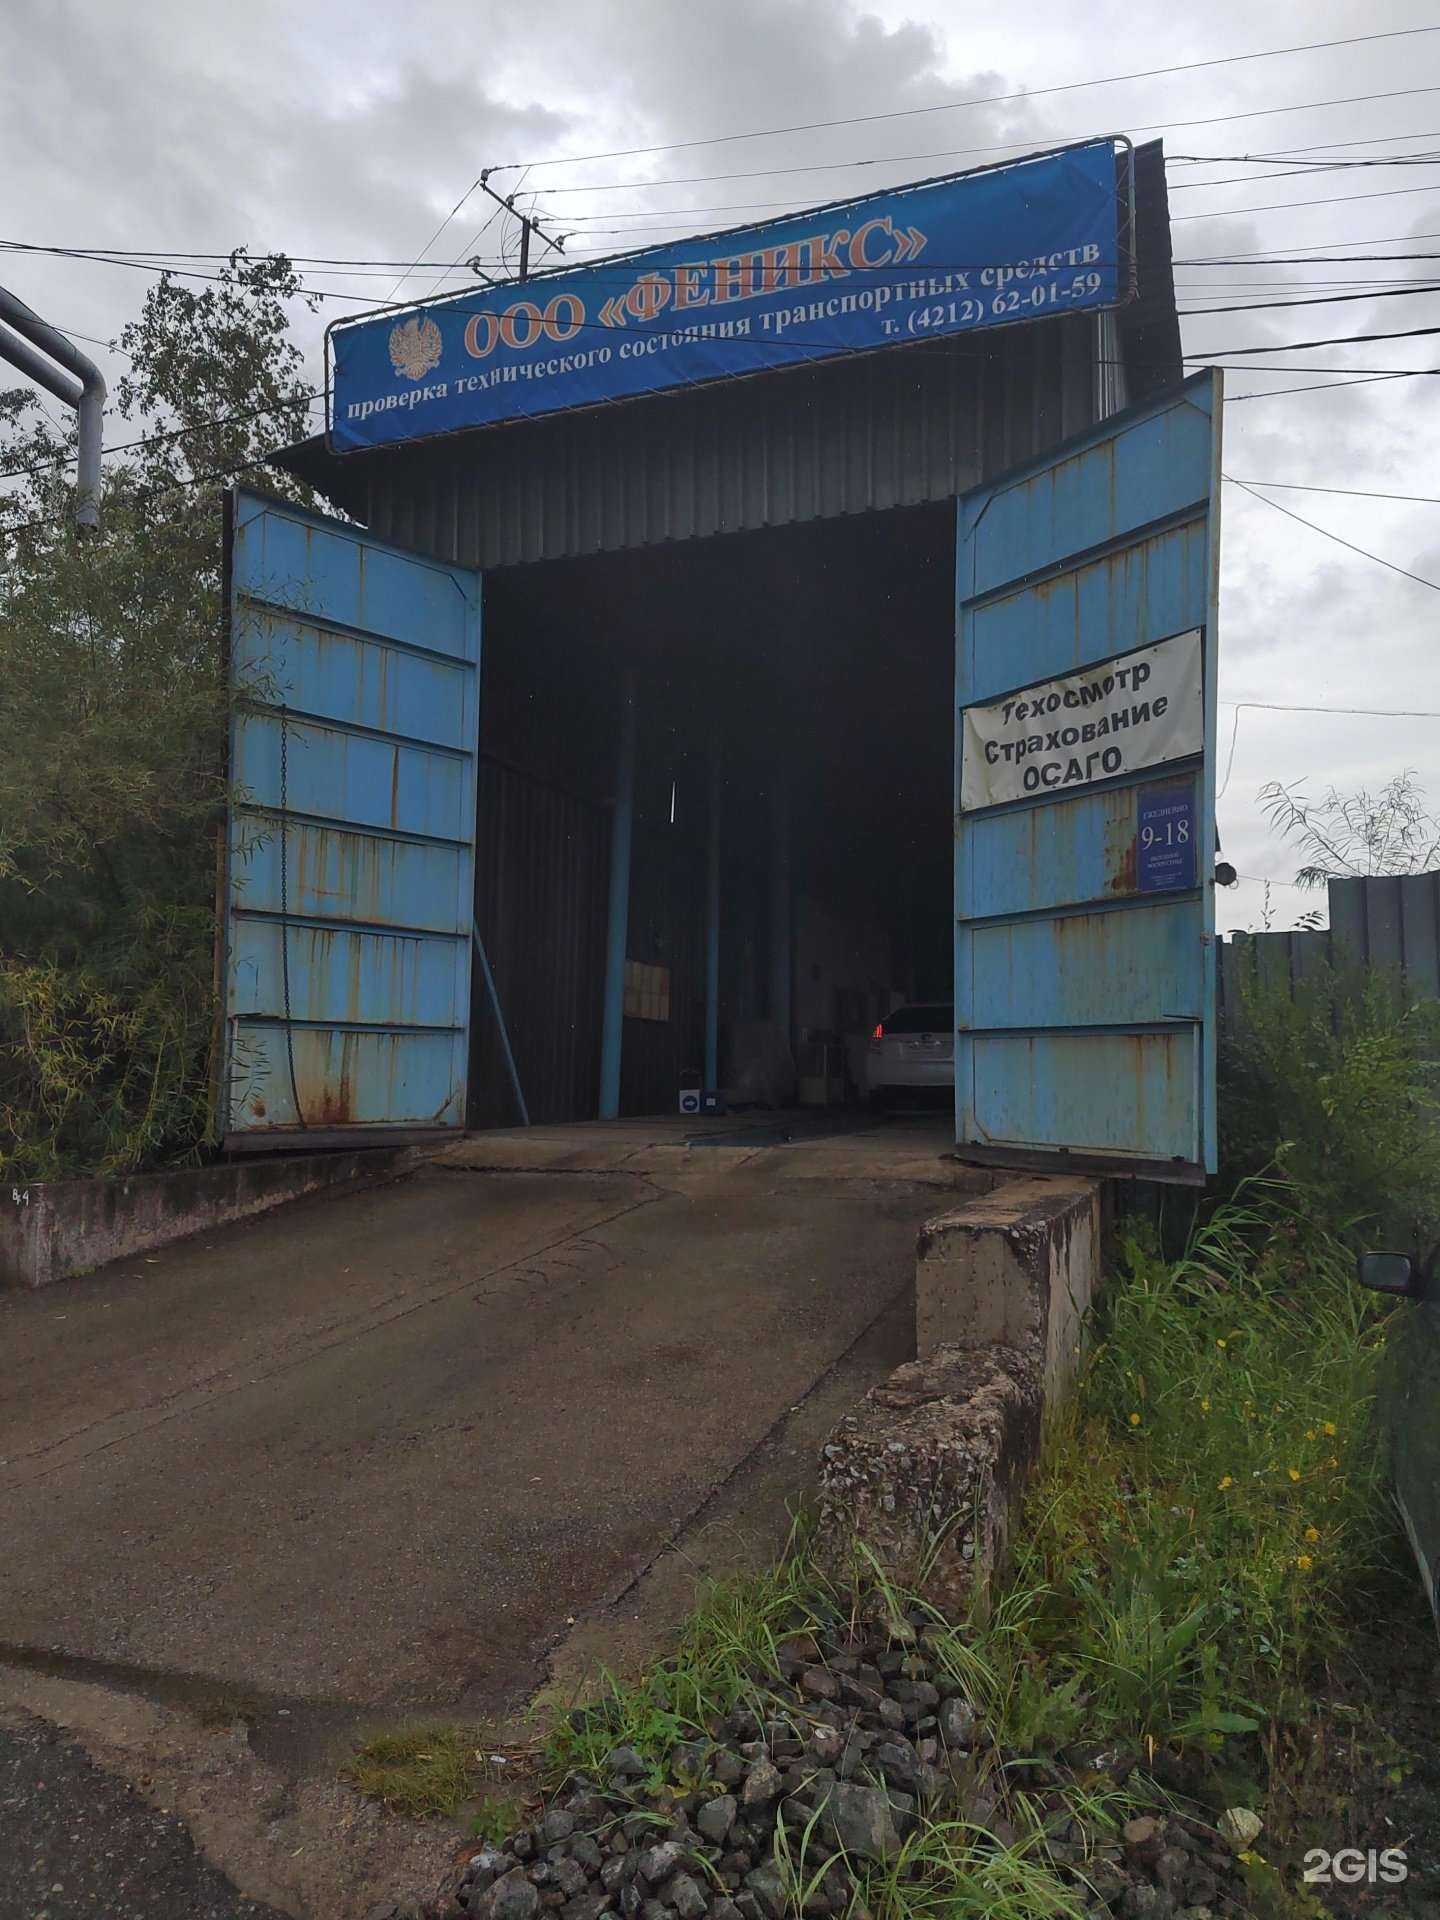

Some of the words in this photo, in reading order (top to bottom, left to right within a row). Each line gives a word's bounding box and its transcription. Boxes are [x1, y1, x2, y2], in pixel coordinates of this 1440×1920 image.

[464, 293, 586, 359] ООО
[598, 215, 929, 329] «ФЕНИКС»
[880, 317, 900, 336] т.
[907, 298, 984, 335] (4212)
[991, 271, 1102, 316] 62-01-59
[346, 381, 448, 421] проверка
[454, 343, 613, 396] технического
[618, 317, 752, 359] состояния
[758, 271, 970, 335] транспортных
[980, 241, 1101, 288] средств
[1001, 660, 1152, 726] Техосмотр
[983, 695, 1169, 765] Страхование
[1022, 745, 1123, 792] ОСАГО
[1141, 818, 1190, 851] 9-18
